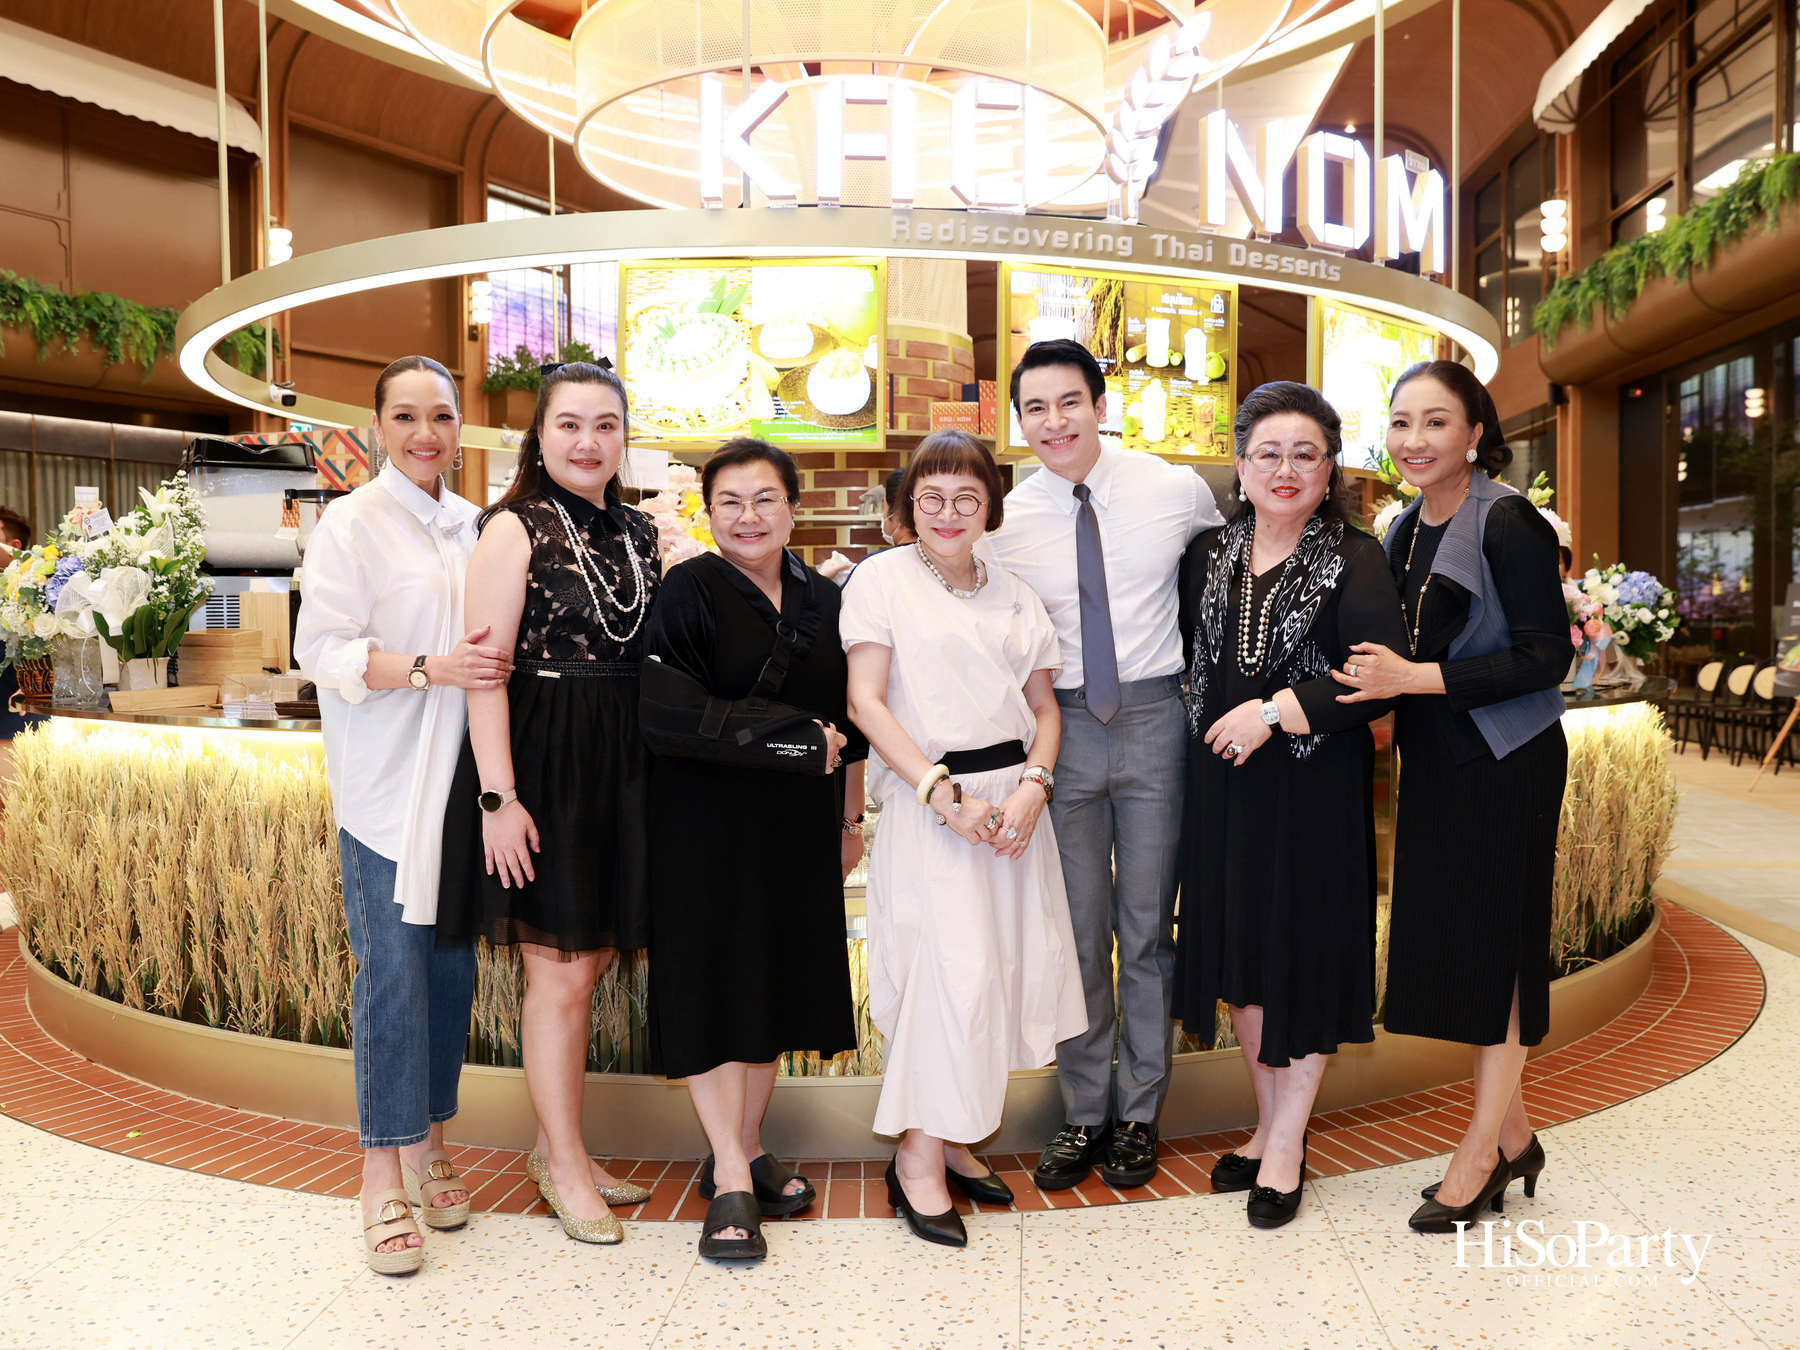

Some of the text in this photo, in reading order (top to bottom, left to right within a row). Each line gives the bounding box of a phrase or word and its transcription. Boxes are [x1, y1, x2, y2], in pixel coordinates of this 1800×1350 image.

[891, 215, 1341, 281] Rediscovering Thai Desserts
[1199, 109, 1444, 274] NOM
